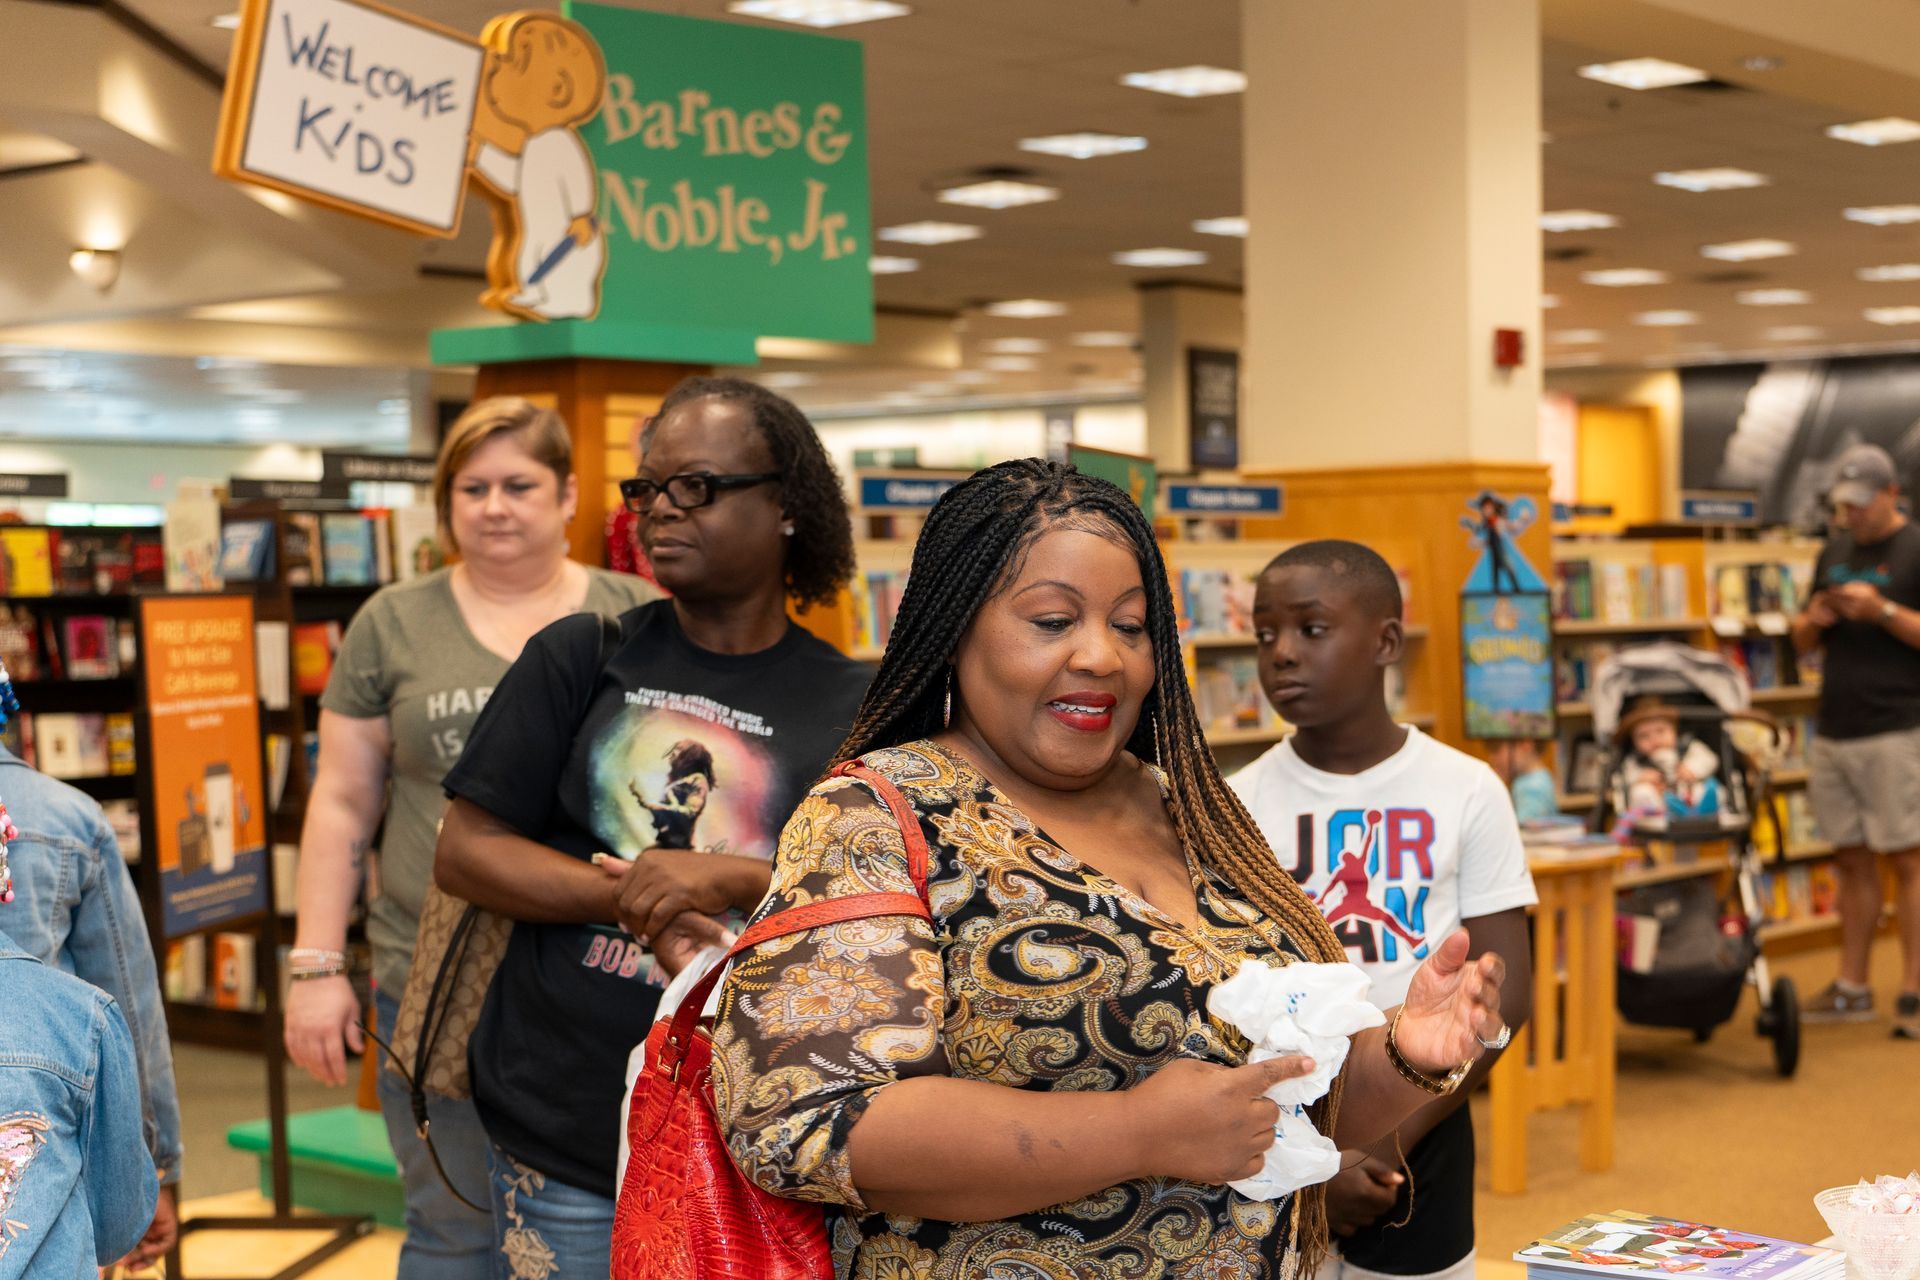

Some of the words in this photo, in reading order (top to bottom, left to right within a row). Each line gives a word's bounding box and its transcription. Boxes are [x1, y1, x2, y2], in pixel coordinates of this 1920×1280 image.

[282, 13, 457, 118] WELCOME
[602, 72, 801, 159] Barnes
[805, 101, 852, 165] &
[600, 167, 784, 266] Noble,
[787, 177, 857, 261] Jr.
[624, 691, 650, 706] THEN
[652, 699, 666, 709] HE
[668, 700, 716, 723] CHANGED
[717, 716, 736, 729] THE
[738, 721, 774, 737] WORLD
[638, 687, 666, 700] FIRST
[668, 692, 683, 702] HE
[683, 694, 730, 717] CHANGED
[731, 709, 764, 727] MUSIC
[581, 934, 643, 978] BOB
